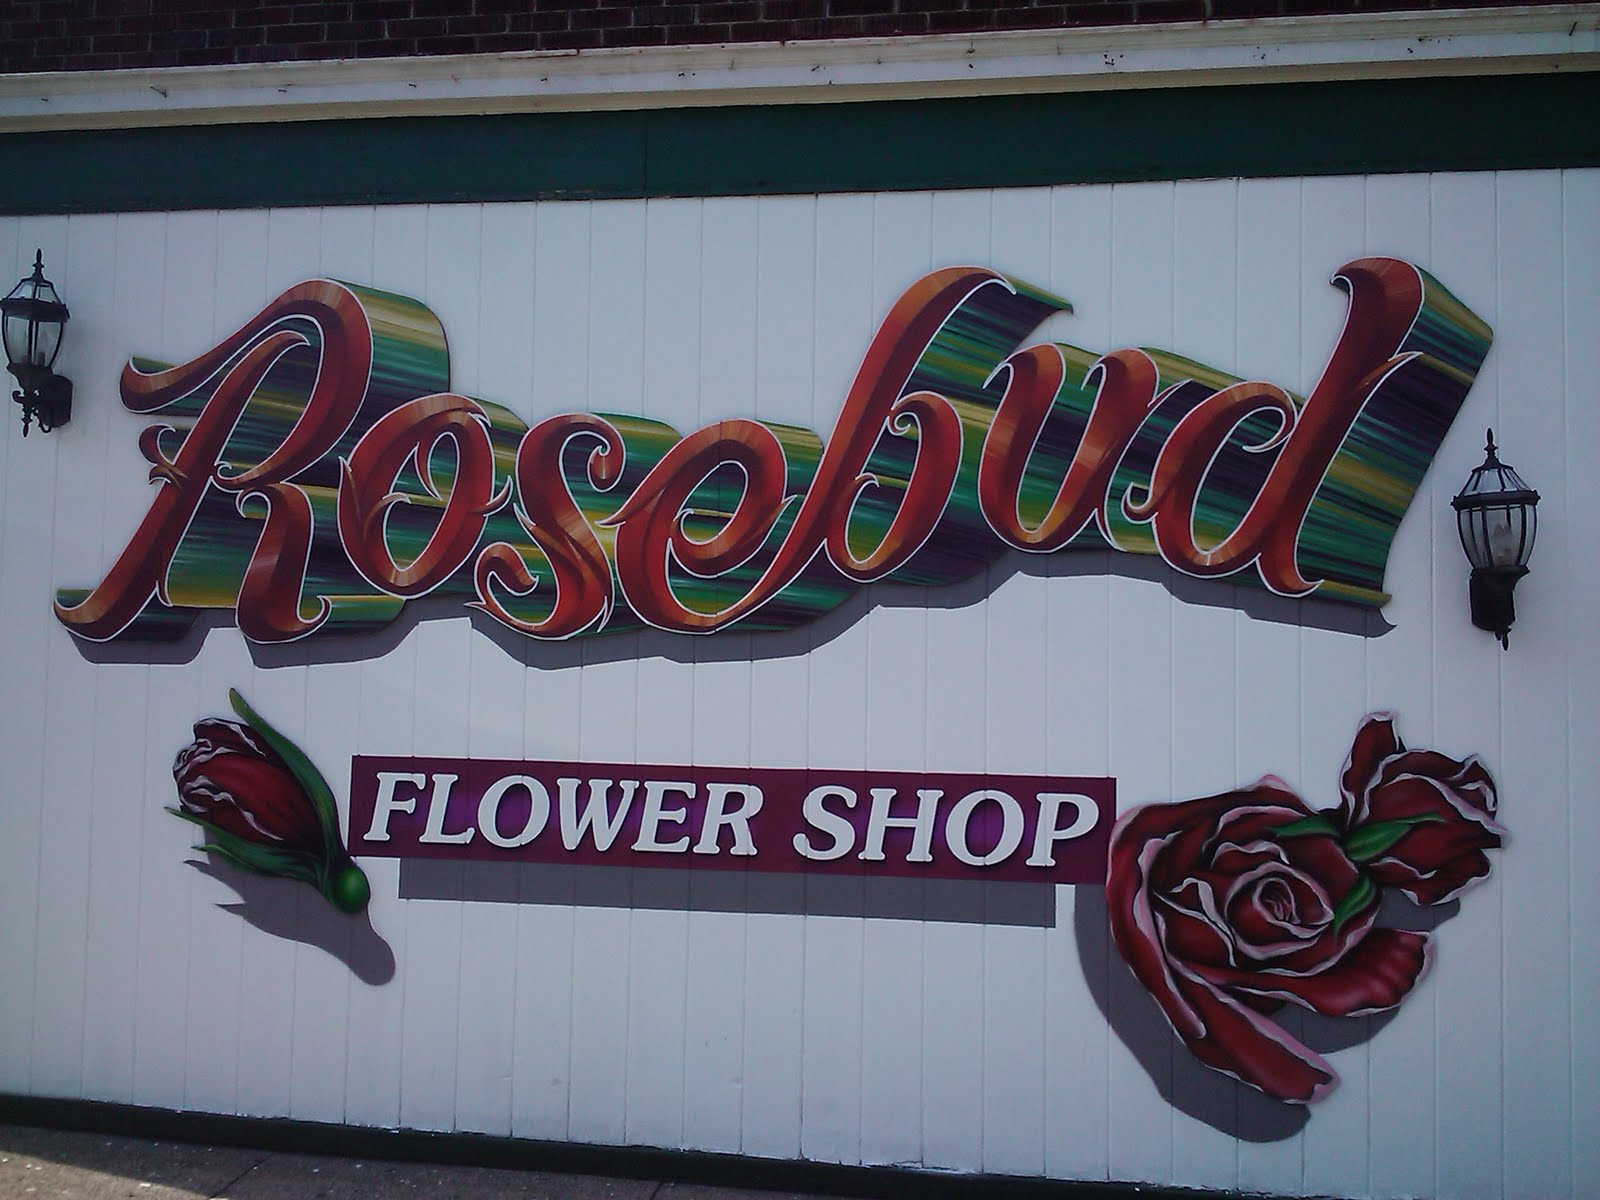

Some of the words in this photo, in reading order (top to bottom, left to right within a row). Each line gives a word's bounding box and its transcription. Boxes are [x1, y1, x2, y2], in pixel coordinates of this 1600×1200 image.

[54, 257, 1426, 643] Rosebud
[362, 772, 764, 856] FLOWER
[792, 785, 1099, 867] SHOP
